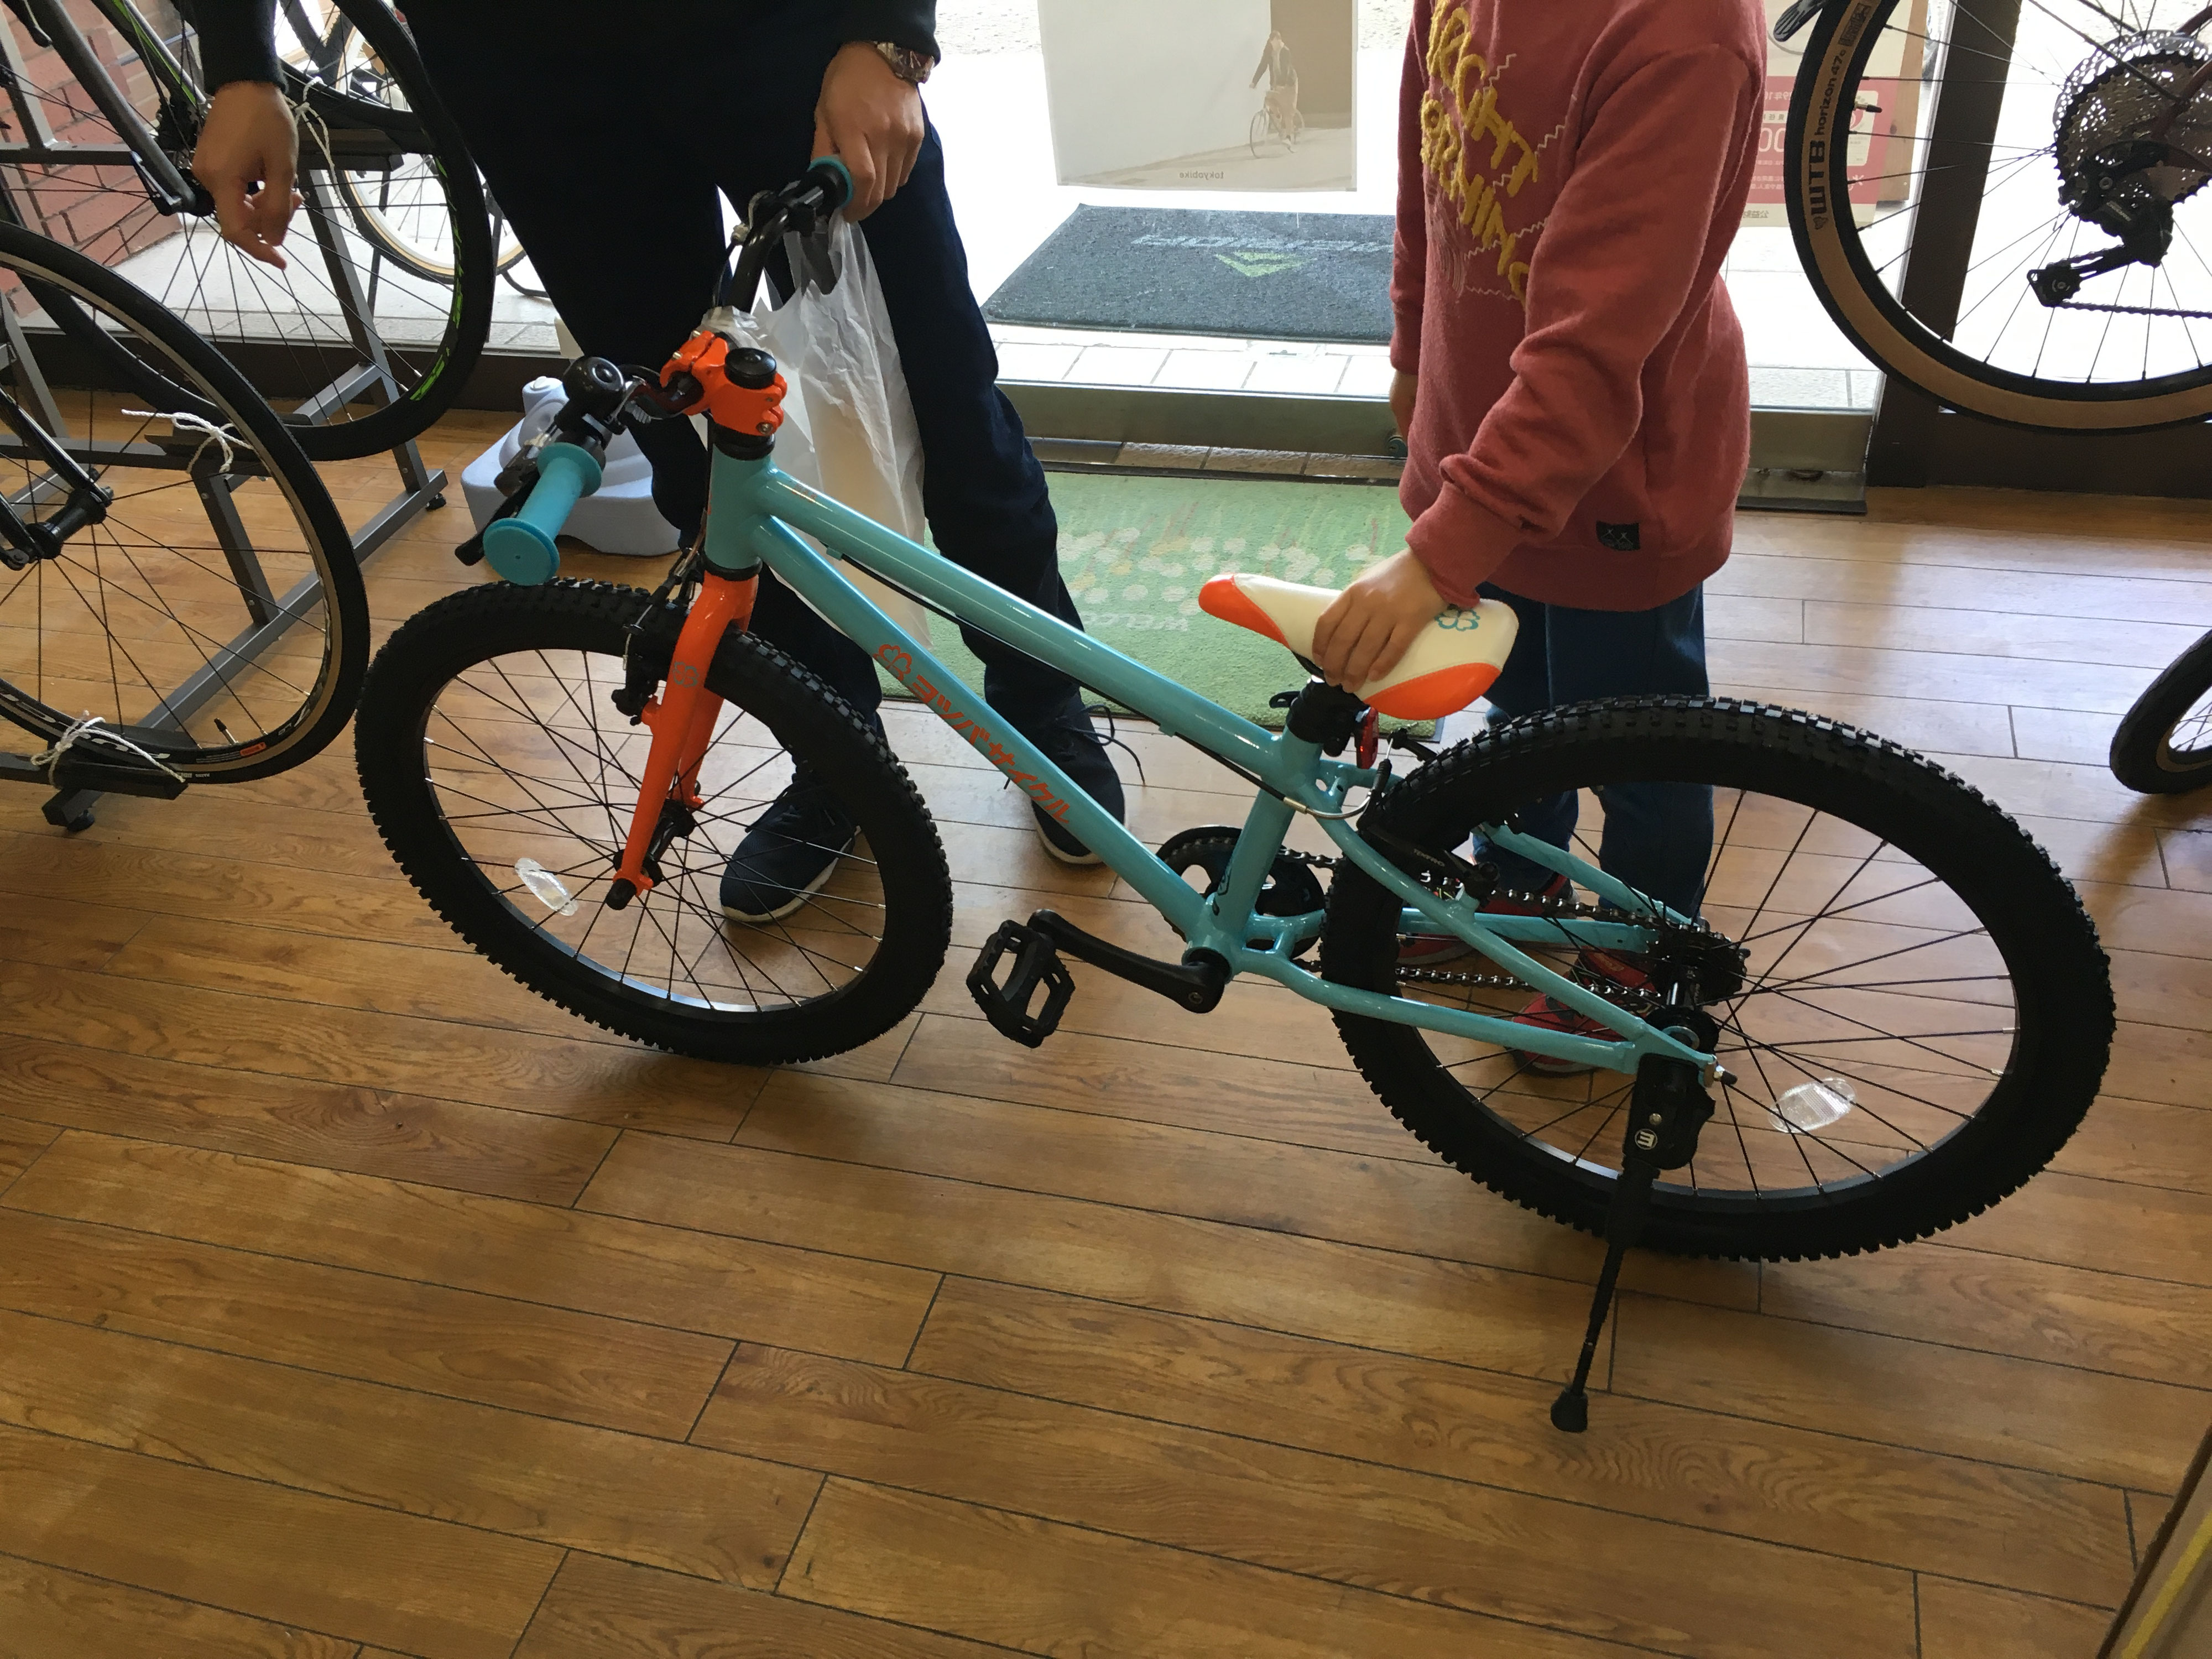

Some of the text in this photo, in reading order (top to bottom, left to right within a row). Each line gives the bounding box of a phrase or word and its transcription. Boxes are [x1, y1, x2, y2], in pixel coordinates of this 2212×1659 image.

[1814, 77, 1835, 135] horizon
[1808, 140, 1827, 216] WTB
[907, 674, 1071, 825] ヨツバサイクル
